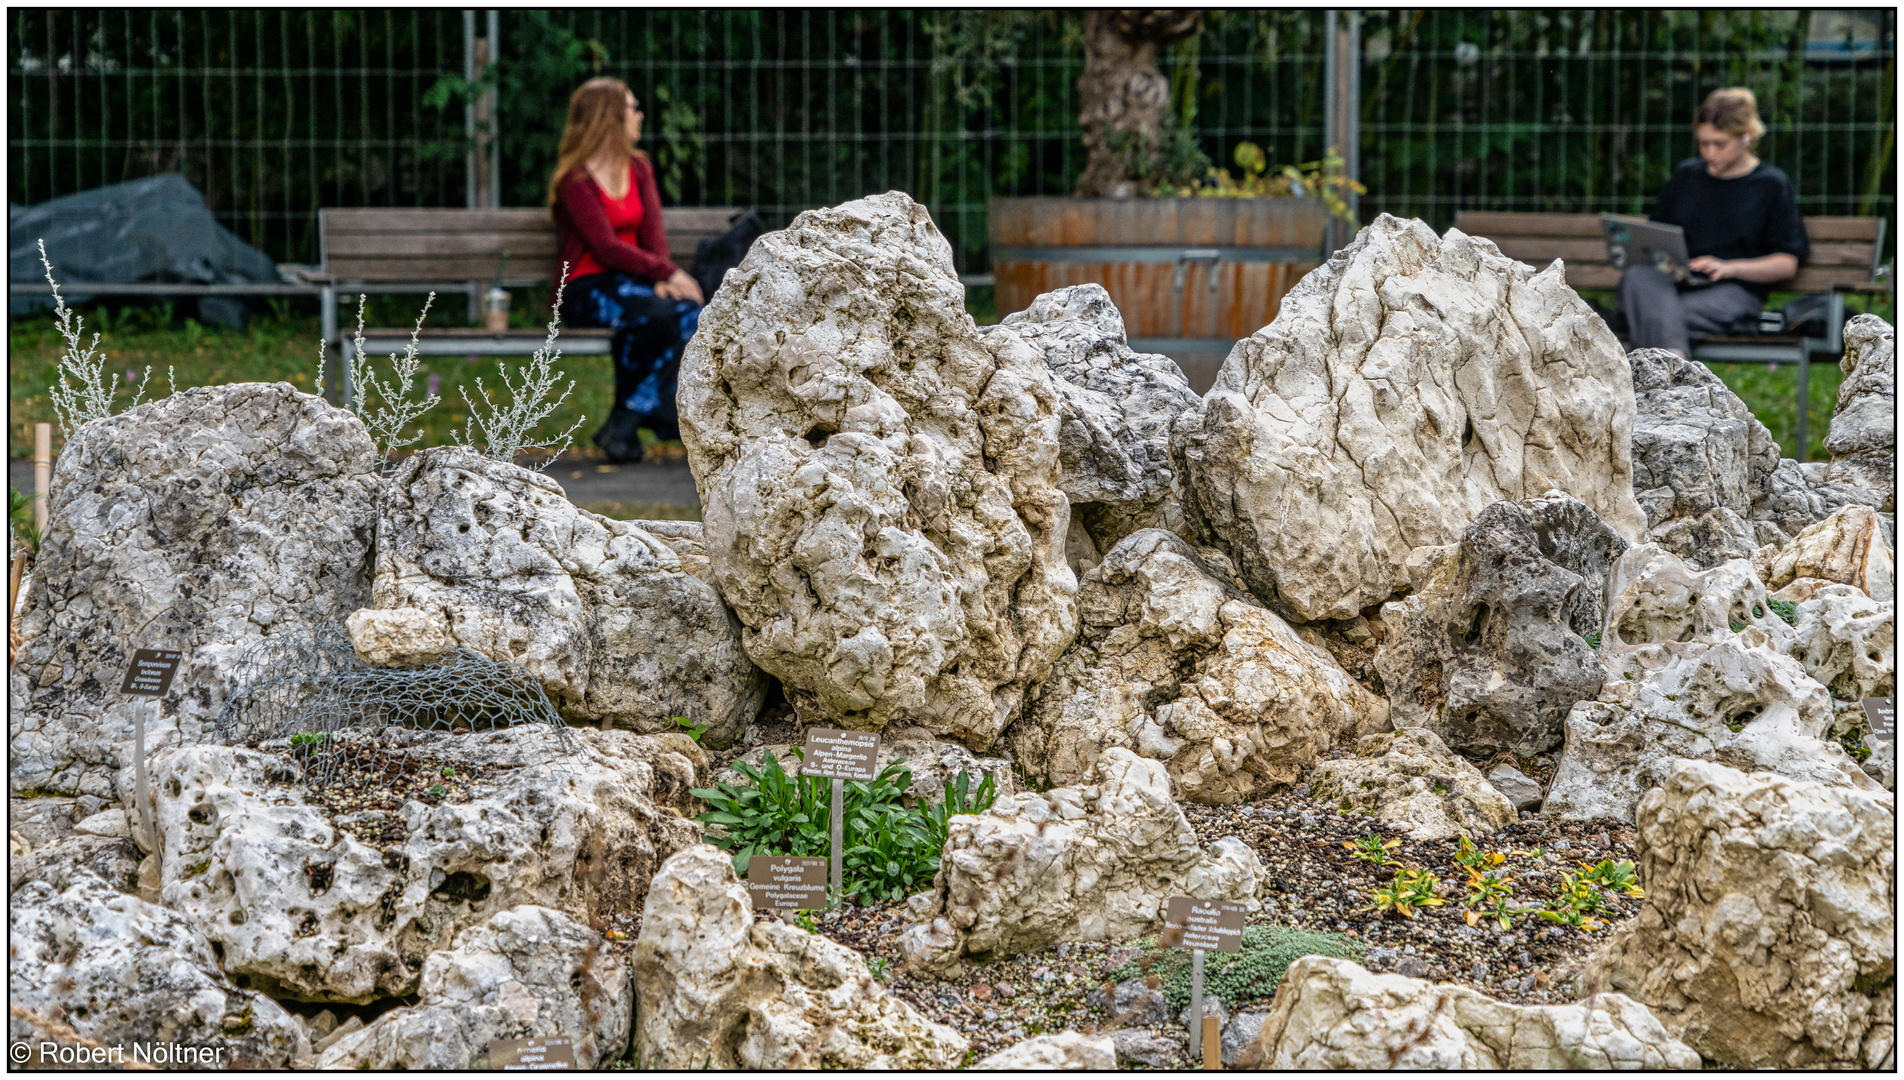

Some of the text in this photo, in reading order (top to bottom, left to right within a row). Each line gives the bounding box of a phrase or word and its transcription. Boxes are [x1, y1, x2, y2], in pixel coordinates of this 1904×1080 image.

[811, 735, 874, 747] Leucanthemopsis
[770, 865, 804, 874] Polygala
[1192, 906, 1221, 916] Raoulia
[1187, 916, 1217, 924] australis
[520, 1055, 544, 1063] alpina
